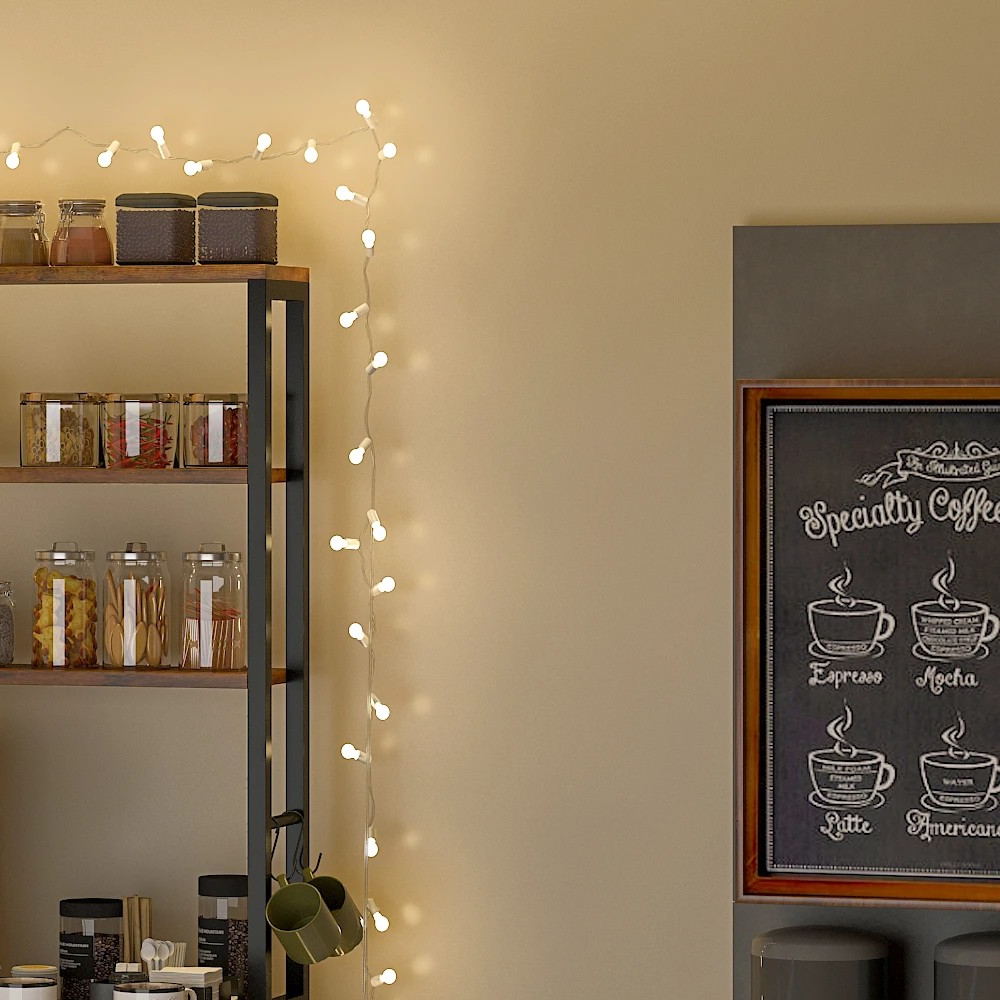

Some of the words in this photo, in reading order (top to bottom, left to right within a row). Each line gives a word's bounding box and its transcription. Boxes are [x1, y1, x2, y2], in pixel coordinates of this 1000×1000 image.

[798, 490, 924, 548] Specialty
[808, 661, 883, 689] Espresso
[915, 666, 978, 695] Mocha
[819, 811, 873, 841] Latte
